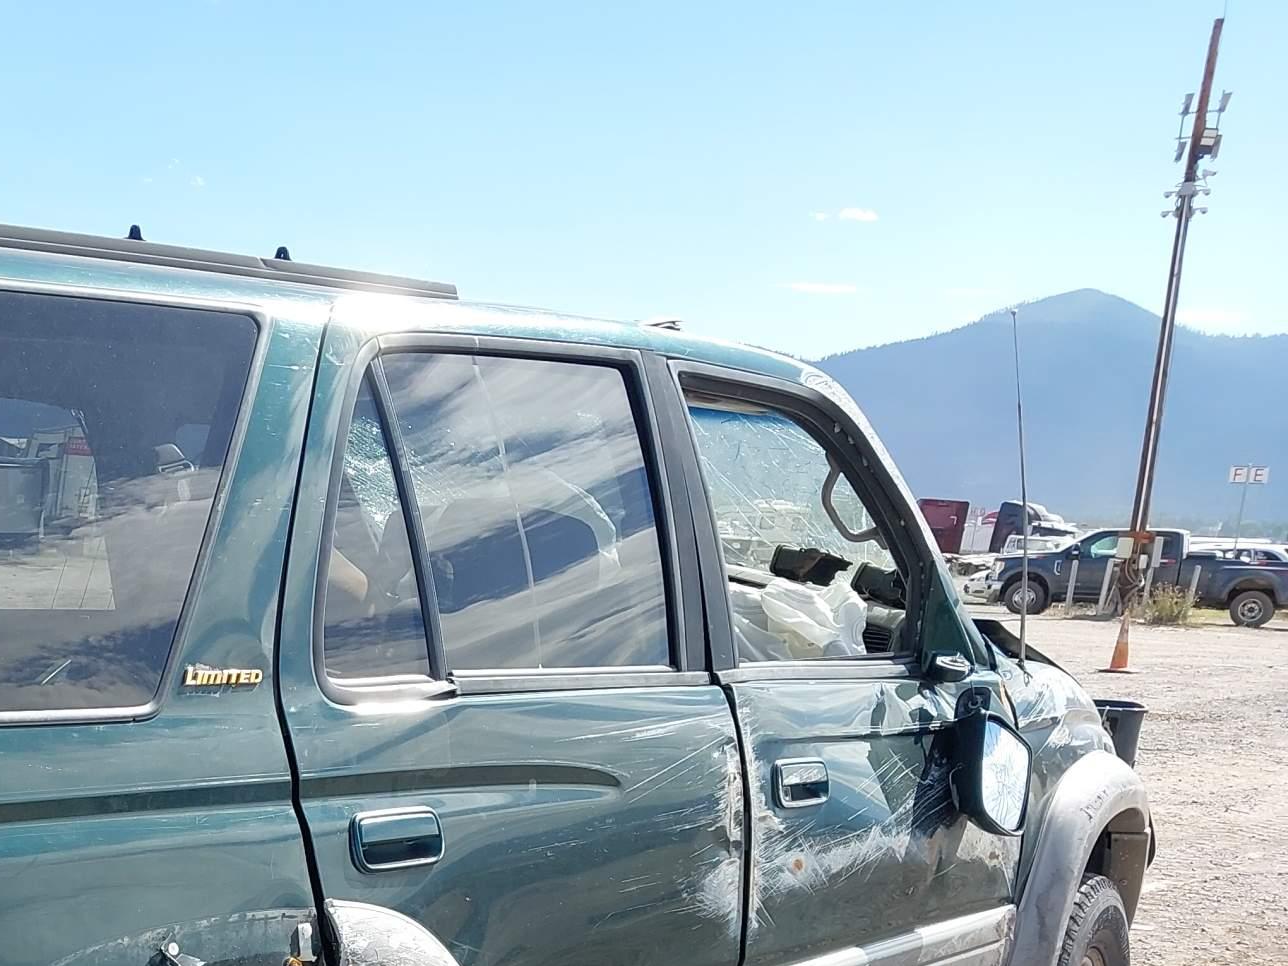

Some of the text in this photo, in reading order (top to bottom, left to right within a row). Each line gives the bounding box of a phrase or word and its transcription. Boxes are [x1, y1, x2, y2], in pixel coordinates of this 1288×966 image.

[1233, 467, 1244, 482] F
[1253, 468, 1265, 483] E
[182, 666, 264, 687] LIMITED
